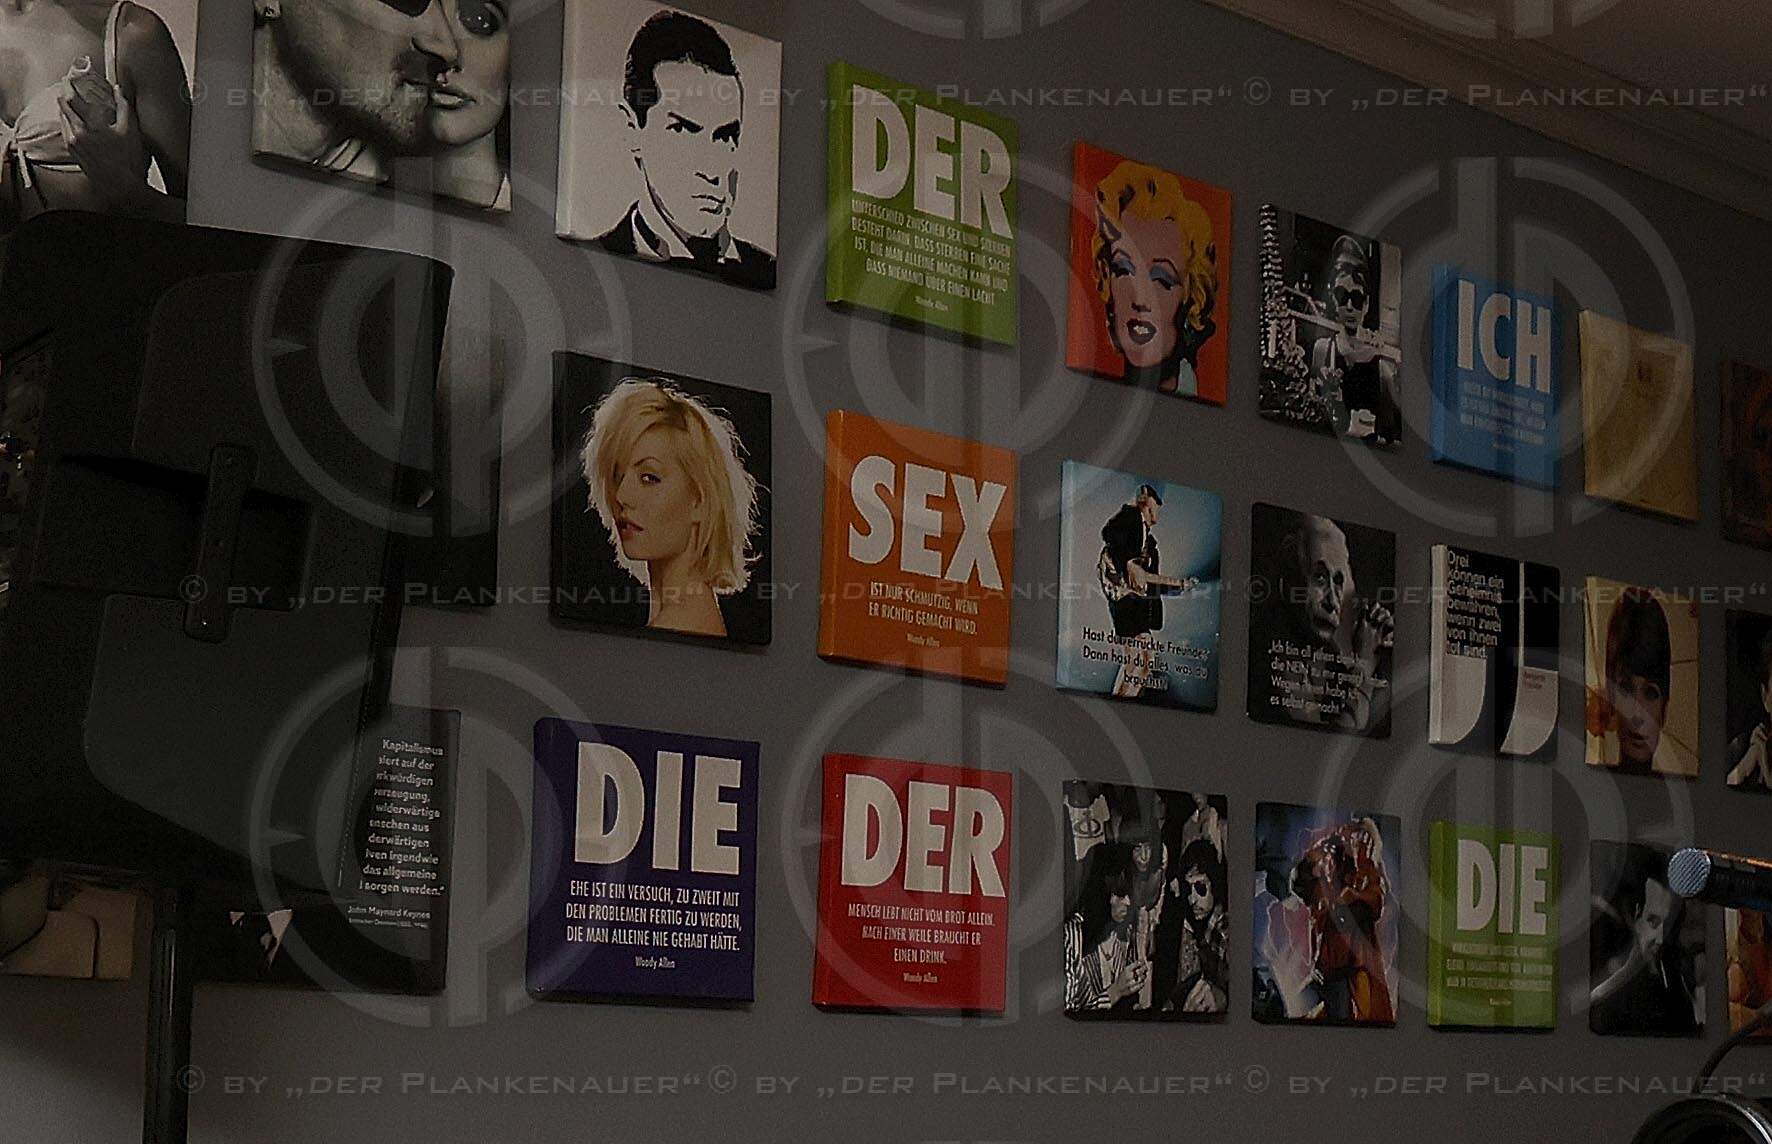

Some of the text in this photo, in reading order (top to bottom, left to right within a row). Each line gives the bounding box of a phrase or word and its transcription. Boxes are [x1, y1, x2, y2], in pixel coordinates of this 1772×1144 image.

[852, 84, 1013, 239] DER
[906, 215, 945, 237] ZWISCHEN
[947, 226, 960, 240] SEX
[914, 235, 934, 253] DASS
[866, 258, 887, 275] DASS
[1457, 279, 1552, 394] ICH
[848, 455, 1007, 591] SEX
[870, 581, 884, 597] IST
[955, 598, 979, 615] WENN
[868, 601, 879, 617] ER
[915, 609, 953, 630] GEMACHT
[1083, 627, 1105, 642] Hast
[1083, 645, 1108, 661] Dann
[1112, 650, 1131, 665] hast
[418, 759, 435, 771] der
[574, 741, 742, 876] DIE
[412, 823, 430, 832] aus
[841, 773, 1007, 898] DER
[570, 880, 740, 907] EHE IST EIN VERSUCH, ZU ZWEIT MIT
[1456, 839, 1549, 935] DIE
[566, 902, 742, 931] DEN PROBLEMEN FERTIG ZU WERDEN,
[848, 903, 881, 919] MENSCH
[882, 905, 900, 920] LEBT
[901, 907, 924, 922] NICHT
[925, 909, 943, 923] VOM
[944, 910, 966, 924] BROT
[567, 926, 740, 951] DIE MAN ALLEINE NIE GEHABT HÄTTE.
[862, 925, 981, 945] NACH EINER WEILE BRAUCHT ER
[894, 948, 918, 963] EINEN
